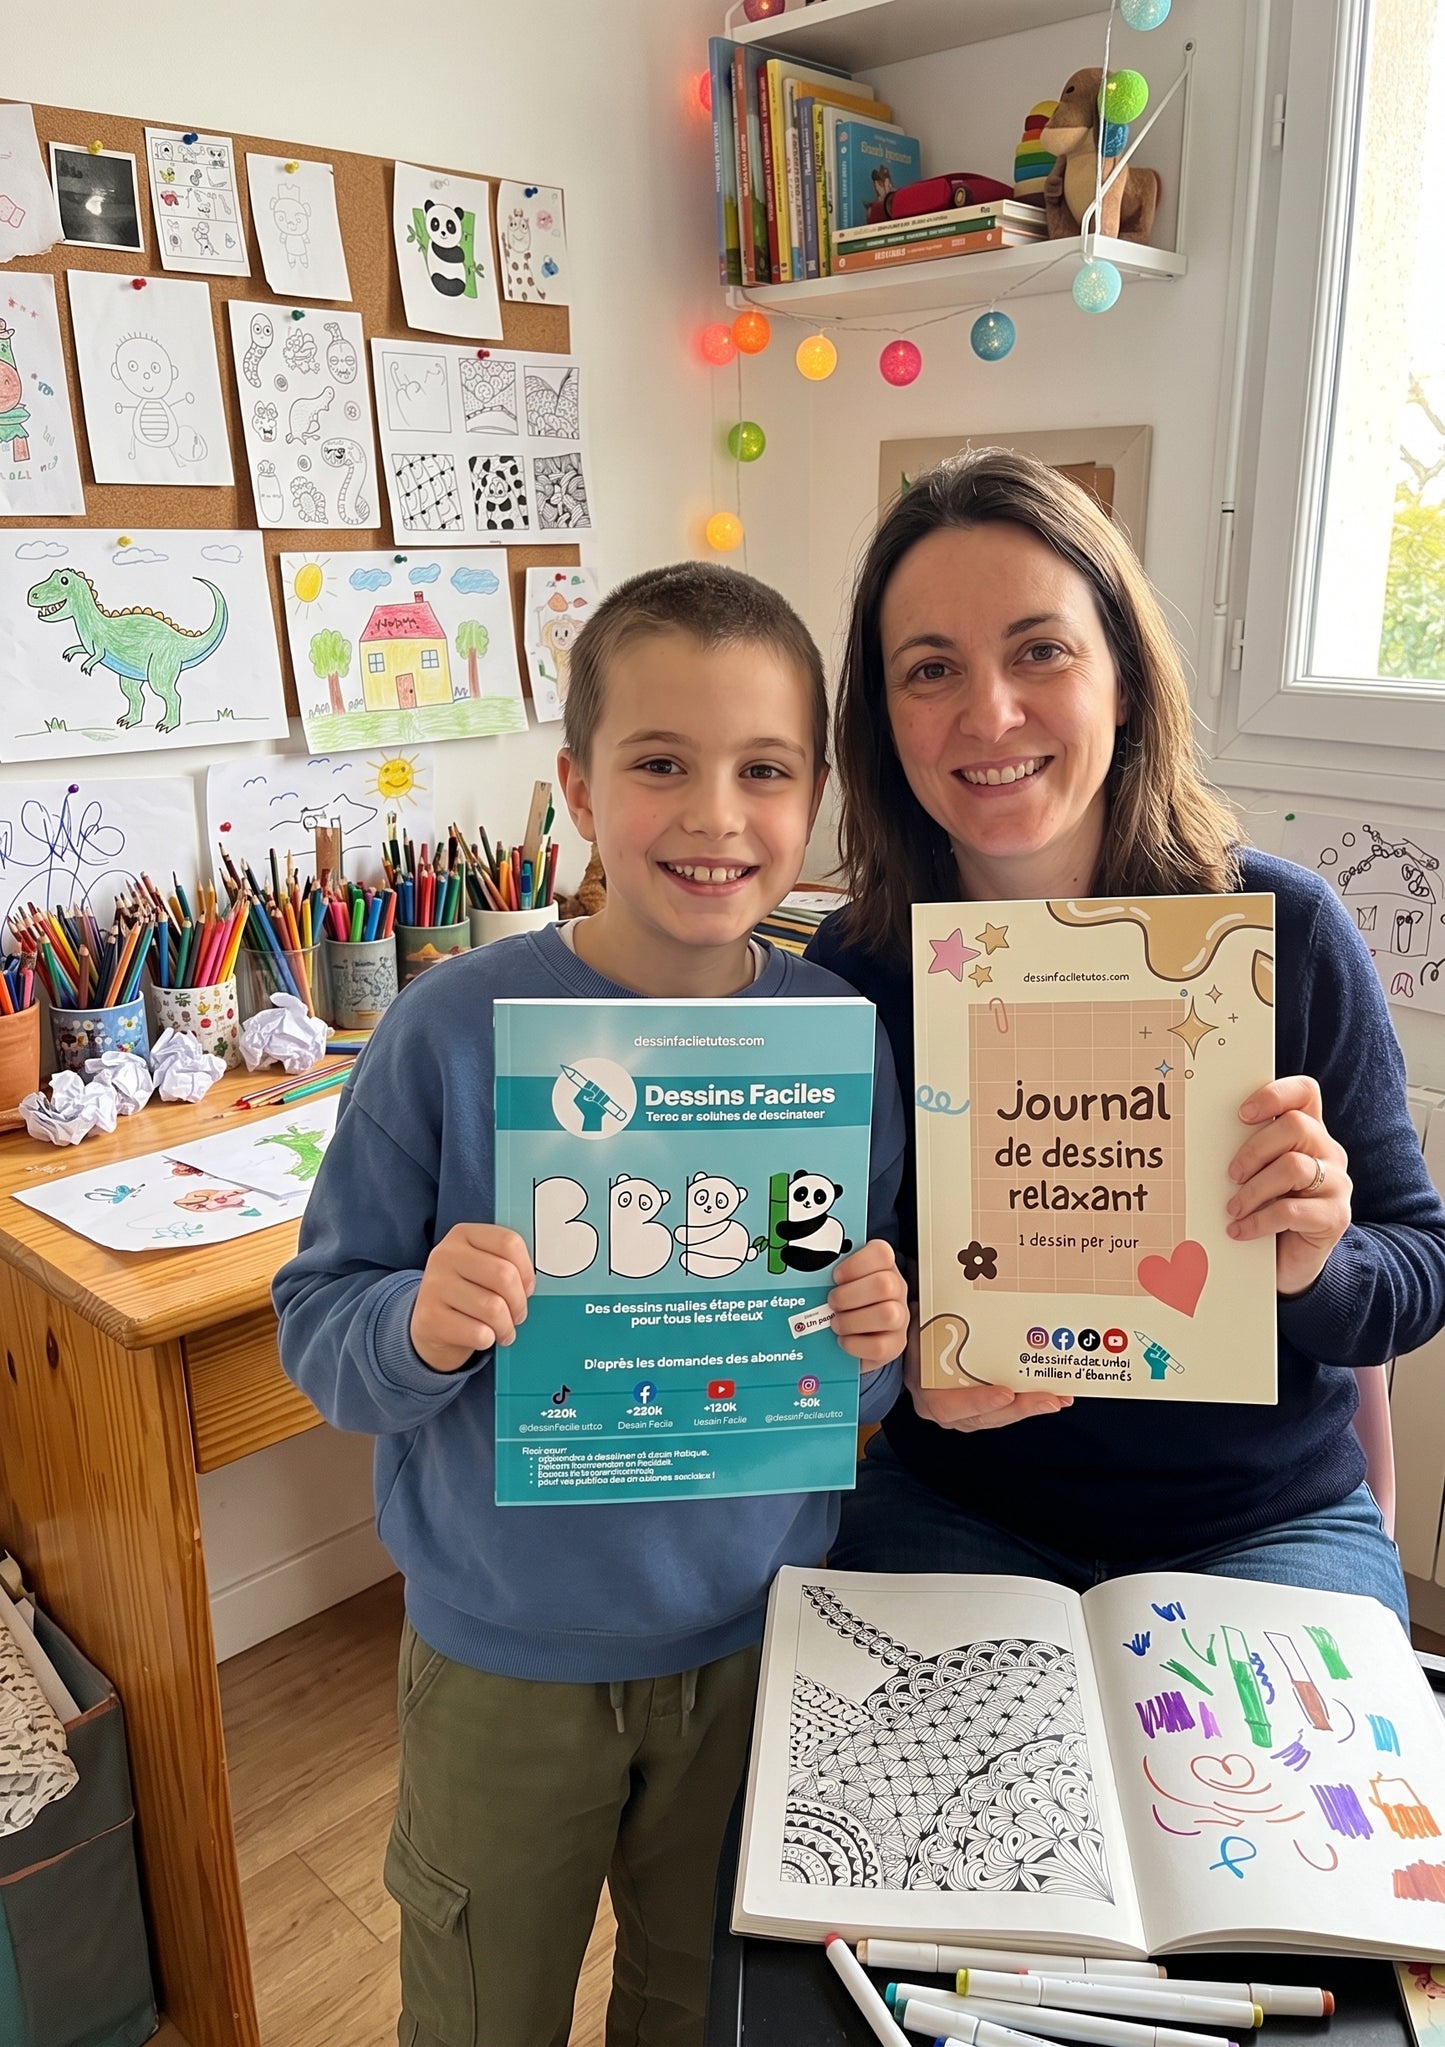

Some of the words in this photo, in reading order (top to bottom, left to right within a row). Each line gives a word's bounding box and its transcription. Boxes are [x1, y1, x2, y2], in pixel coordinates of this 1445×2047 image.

[645, 1084, 744, 1106] Dessins
[749, 1082, 835, 1104] Faciles
[997, 1080, 1171, 1121] journal
[742, 1110, 757, 1121] de
[995, 1136, 1032, 1167] de
[1042, 1136, 1163, 1168] dessins
[1009, 1180, 1148, 1211] relaxant
[1019, 1234, 1025, 1246] 1
[1030, 1232, 1076, 1247] dessin
[1081, 1235, 1104, 1253] per
[1108, 1235, 1139, 1253] jour
[585, 1303, 610, 1314] Des
[613, 1301, 663, 1313] dessins
[709, 1298, 745, 1312] étape
[747, 1299, 768, 1311] par
[770, 1296, 805, 1309] étape
[631, 1316, 661, 1328] pour
[663, 1314, 691, 1324] tous
[694, 1313, 713, 1323] les
[636, 1357, 655, 1368] les
[725, 1353, 748, 1365] des
[751, 1349, 803, 1363] abonnés
[704, 1402, 737, 1413] +120k
